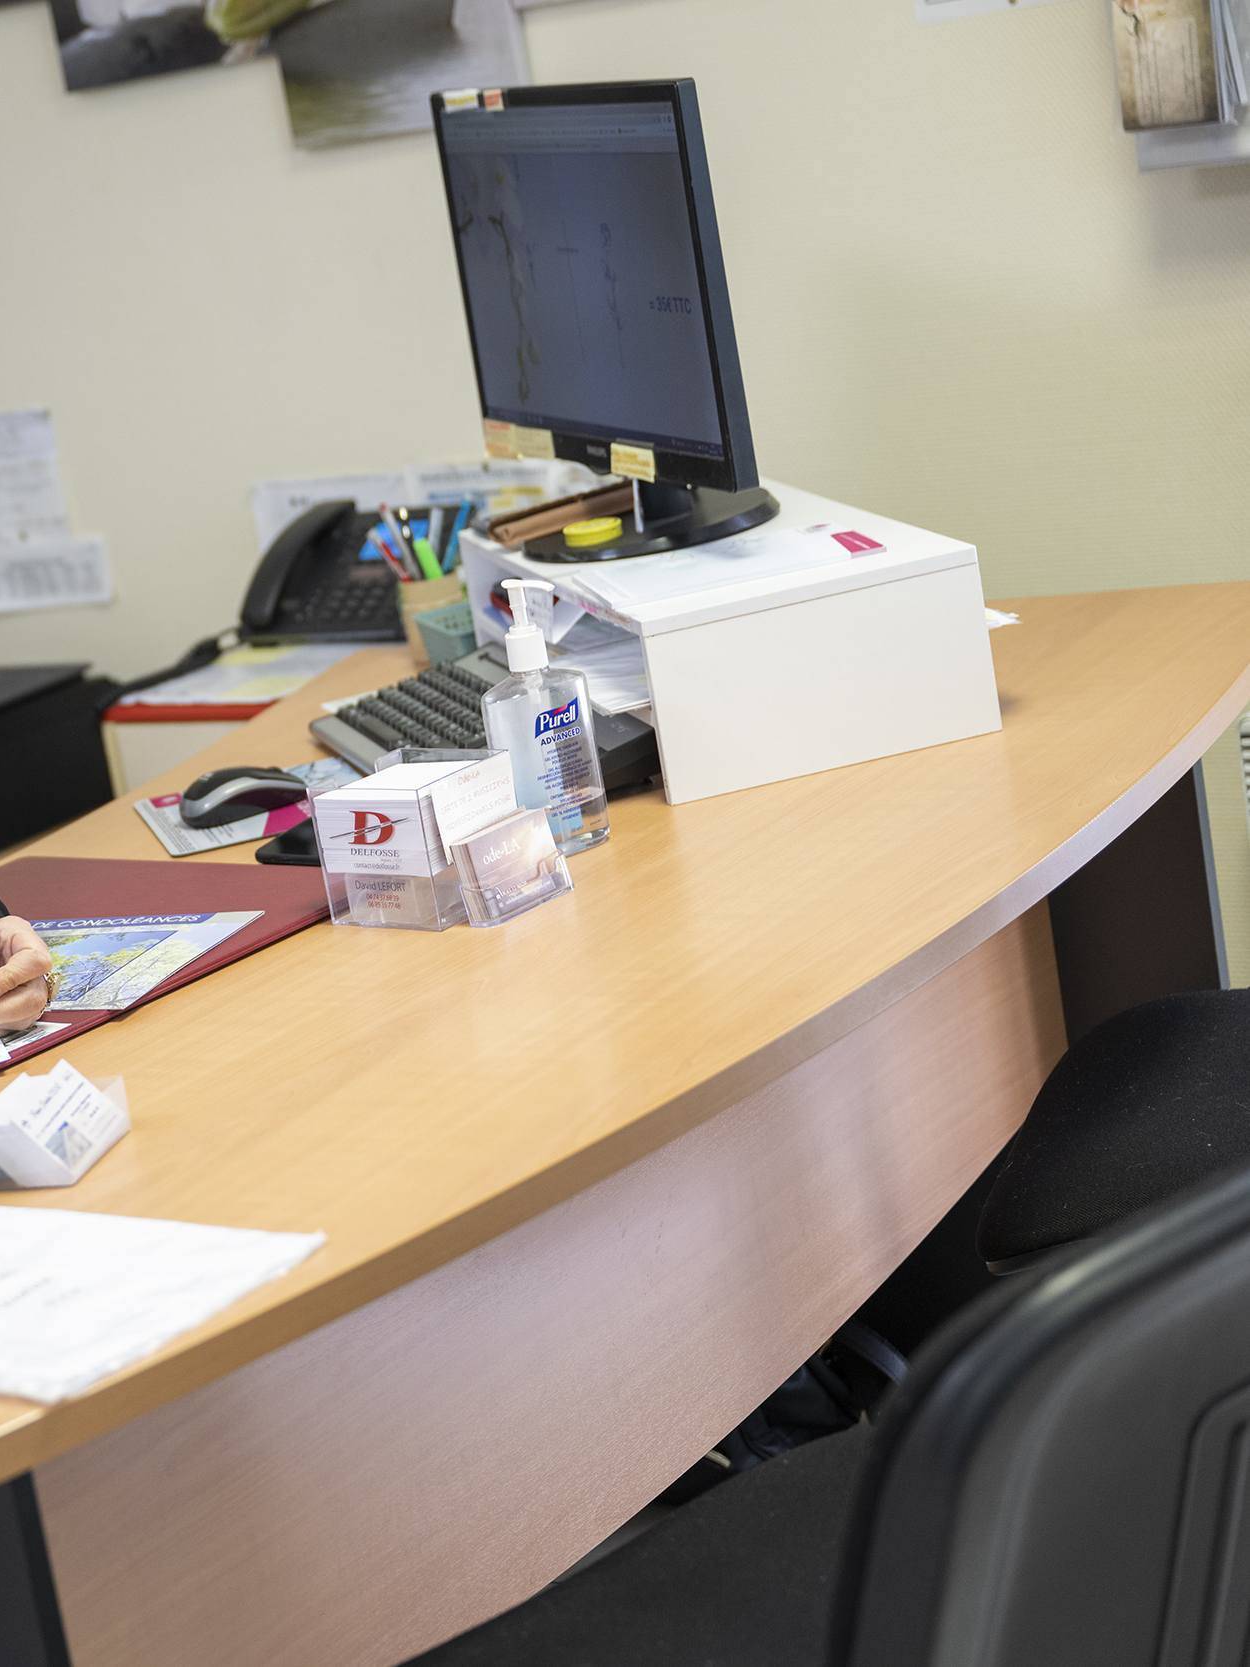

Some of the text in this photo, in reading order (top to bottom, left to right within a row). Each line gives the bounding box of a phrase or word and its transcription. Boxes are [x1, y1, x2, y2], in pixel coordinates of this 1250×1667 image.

[539, 704, 576, 732] Purell
[540, 727, 581, 747] ADVANCED
[350, 848, 400, 858] DELFOSSE
[354, 879, 406, 892] David LEFORT
[32, 921, 51, 929] DE
